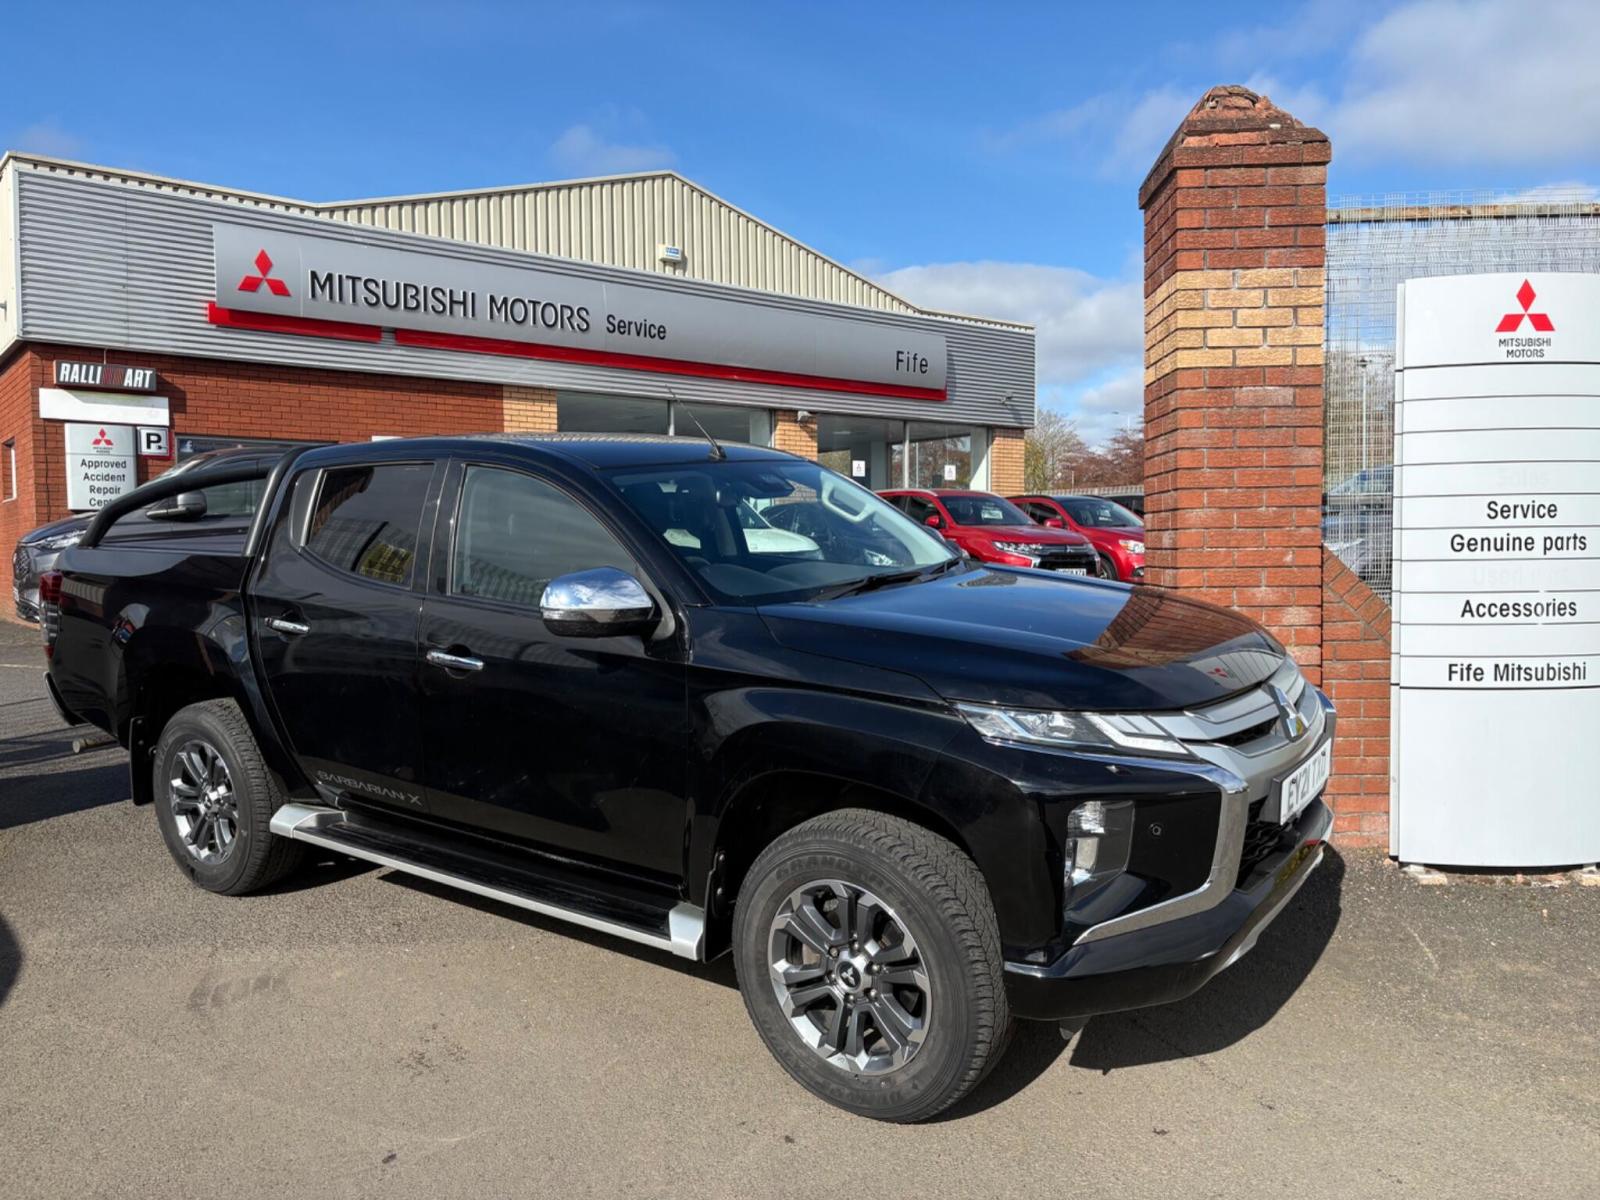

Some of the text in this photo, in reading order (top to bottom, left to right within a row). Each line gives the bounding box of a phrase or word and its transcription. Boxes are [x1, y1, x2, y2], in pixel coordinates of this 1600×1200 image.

[309, 270, 667, 341] MITSUBISHI MOTORS Service
[1498, 337, 1552, 348] MITSUBISHI
[895, 350, 929, 375] Fife
[1506, 348, 1545, 359] MOTORS
[146, 432, 162, 450] P
[80, 458, 127, 470] Approved
[83, 472, 126, 483] Accident
[89, 484, 121, 496] Repair
[89, 497, 112, 508] Cen
[1486, 499, 1558, 520] Service
[1450, 532, 1587, 556] Genuine parts
[1460, 598, 1577, 618] Accessories
[1448, 661, 1587, 682] Fife Mitsubishi
[317, 770, 405, 800] BARBARIAN
